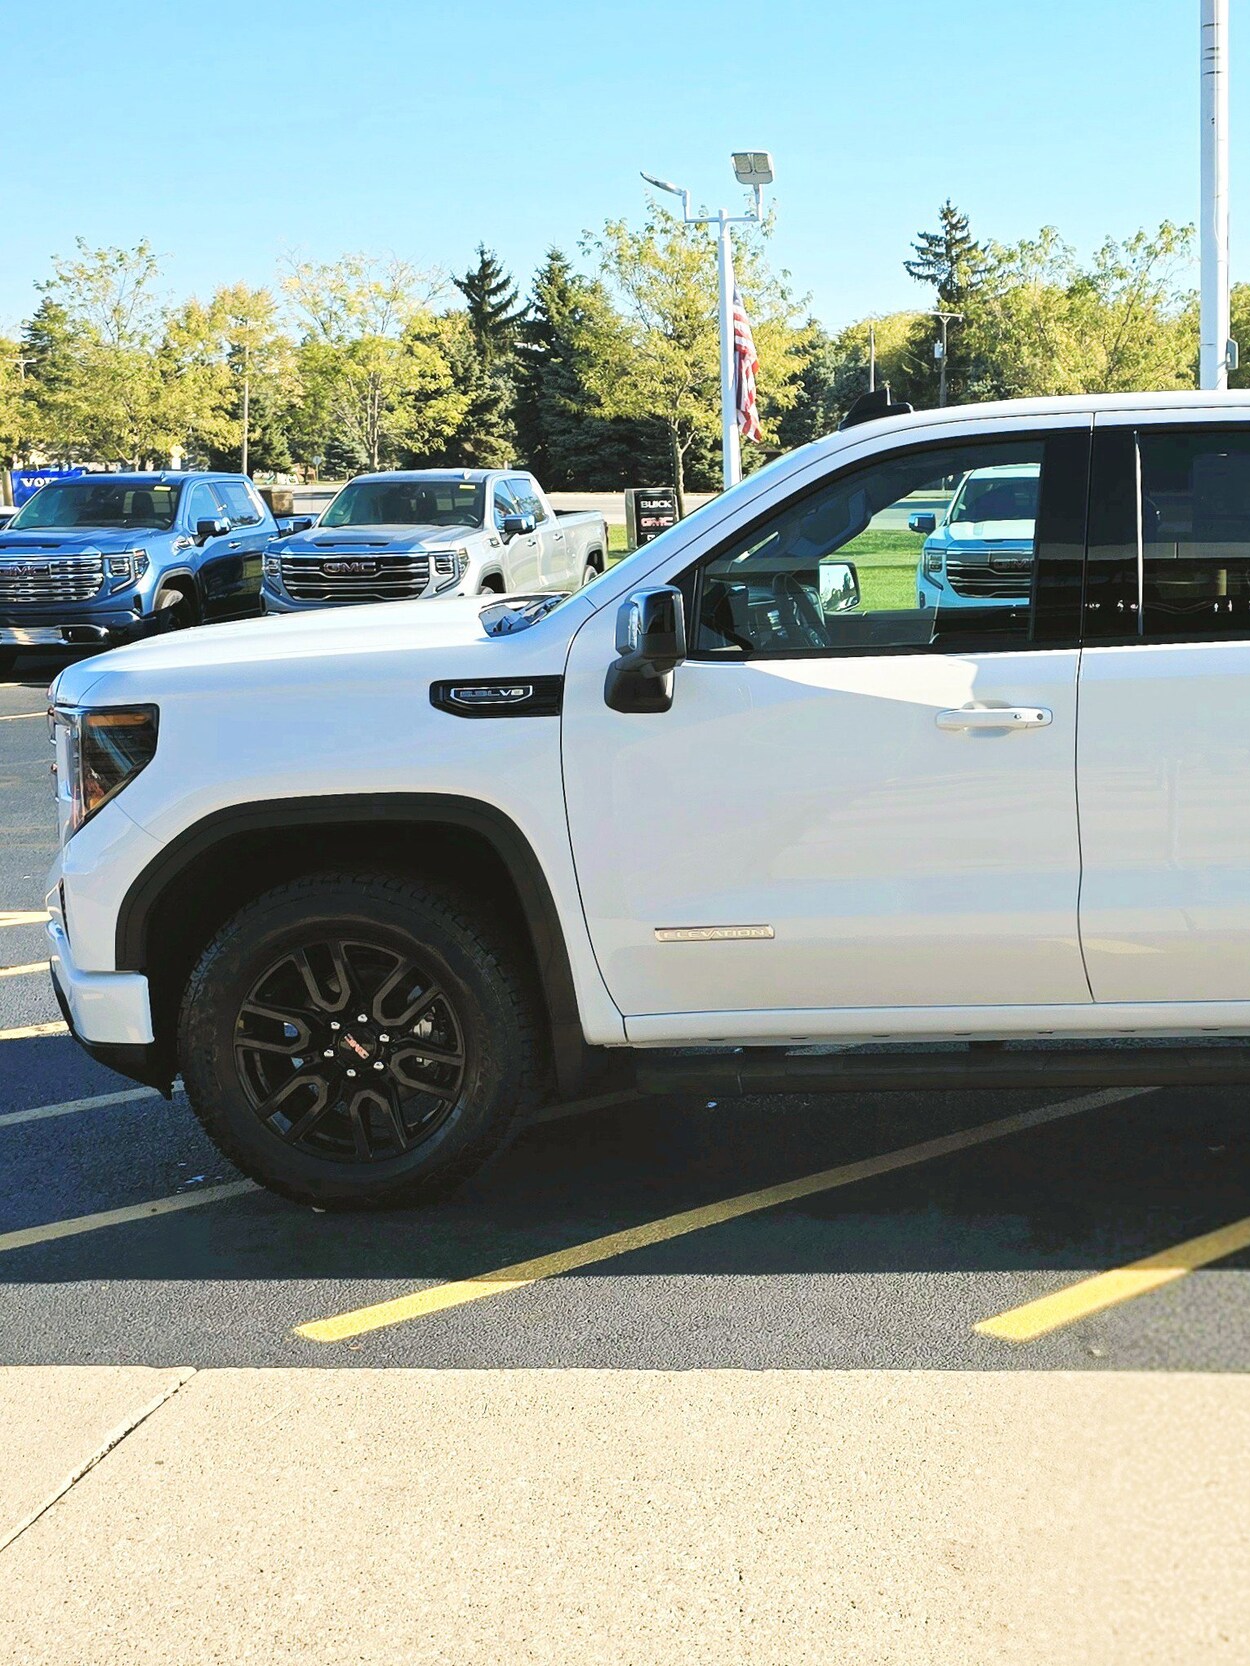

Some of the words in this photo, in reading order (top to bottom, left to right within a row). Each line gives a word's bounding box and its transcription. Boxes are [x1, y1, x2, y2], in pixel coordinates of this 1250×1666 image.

[641, 517, 673, 526] GMC
[323, 561, 377, 573] GMC
[663, 928, 767, 939] ELEVATION
